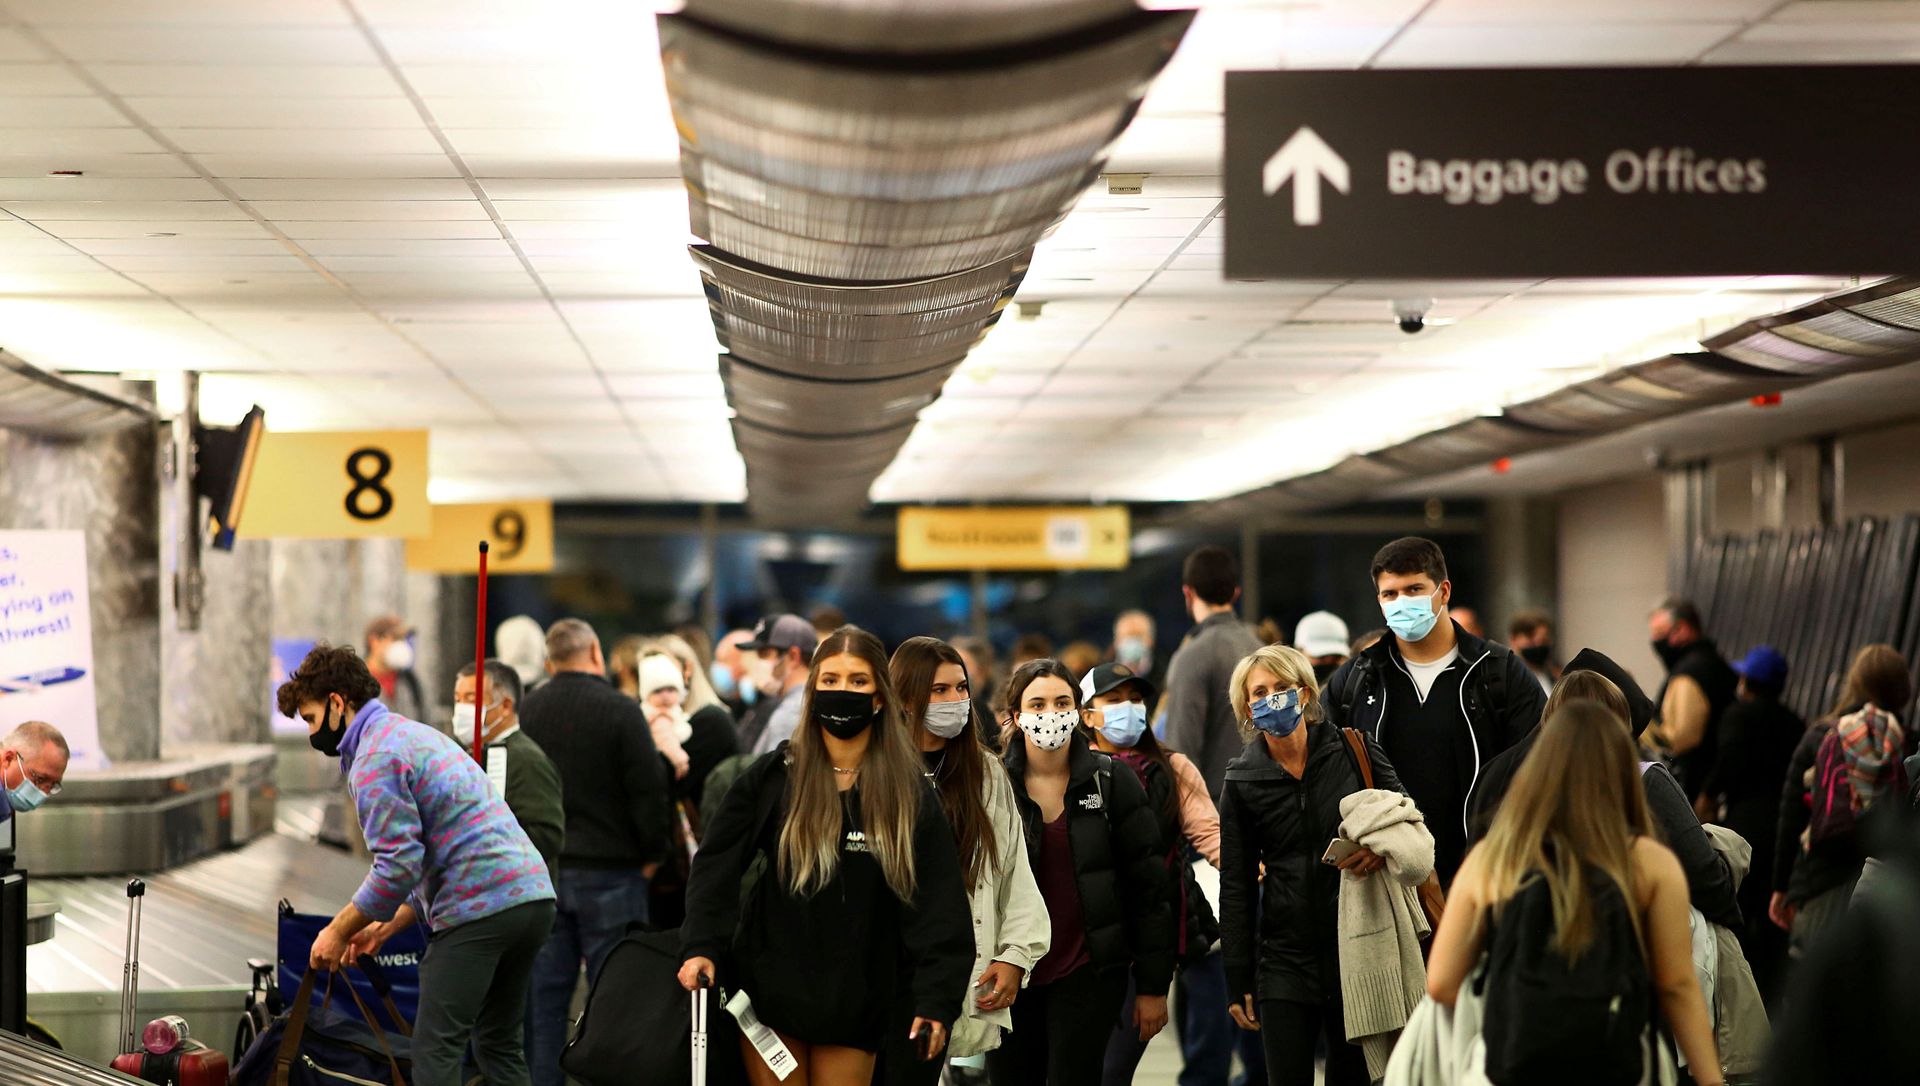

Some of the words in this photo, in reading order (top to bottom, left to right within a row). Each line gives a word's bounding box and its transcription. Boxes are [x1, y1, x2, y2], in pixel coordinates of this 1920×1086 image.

[1387, 149, 1588, 205] Baggage
[1605, 146, 1768, 194] Offices
[344, 446, 394, 521] 8
[491, 508, 528, 561] 9
[49, 589, 75, 604] on
